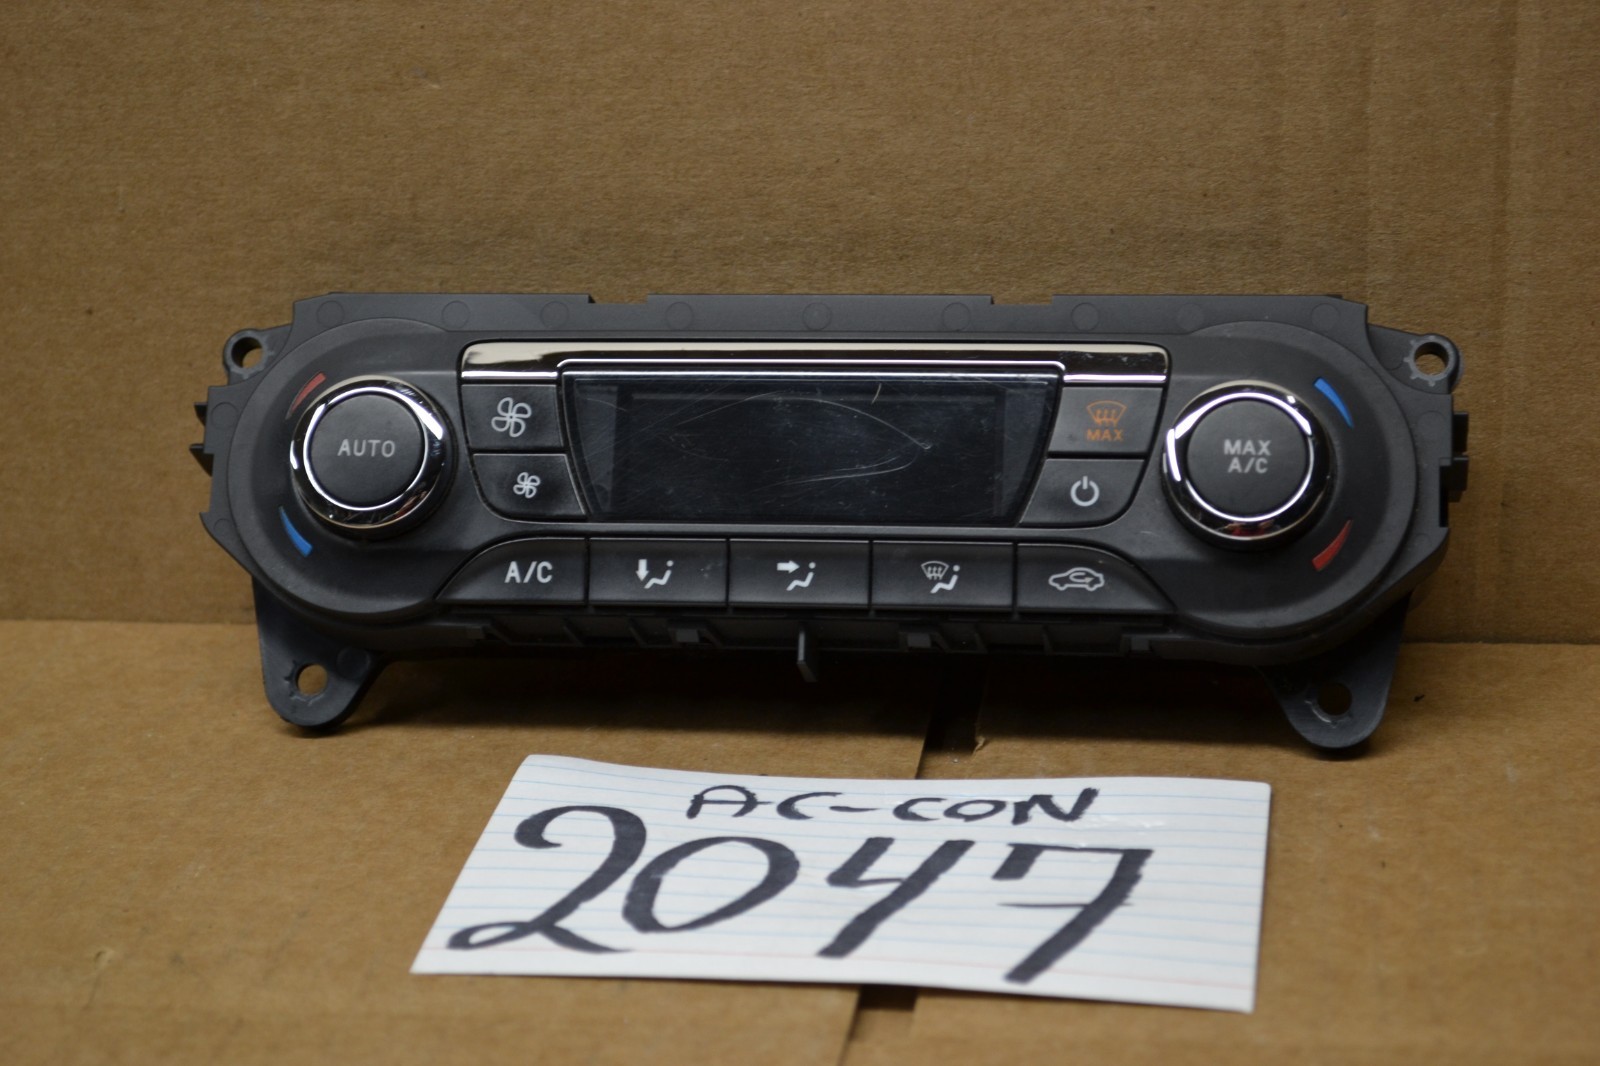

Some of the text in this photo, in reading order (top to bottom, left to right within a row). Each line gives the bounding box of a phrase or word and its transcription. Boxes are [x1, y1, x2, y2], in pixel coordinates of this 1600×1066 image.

[1086, 428, 1124, 442] MAX
[338, 439, 396, 458] AUTO
[1223, 439, 1271, 456] MAX
[1227, 457, 1268, 475] A/C
[504, 561, 553, 584] A/C
[687, 785, 1098, 825] AC-CON
[449, 805, 1153, 984] 2047
